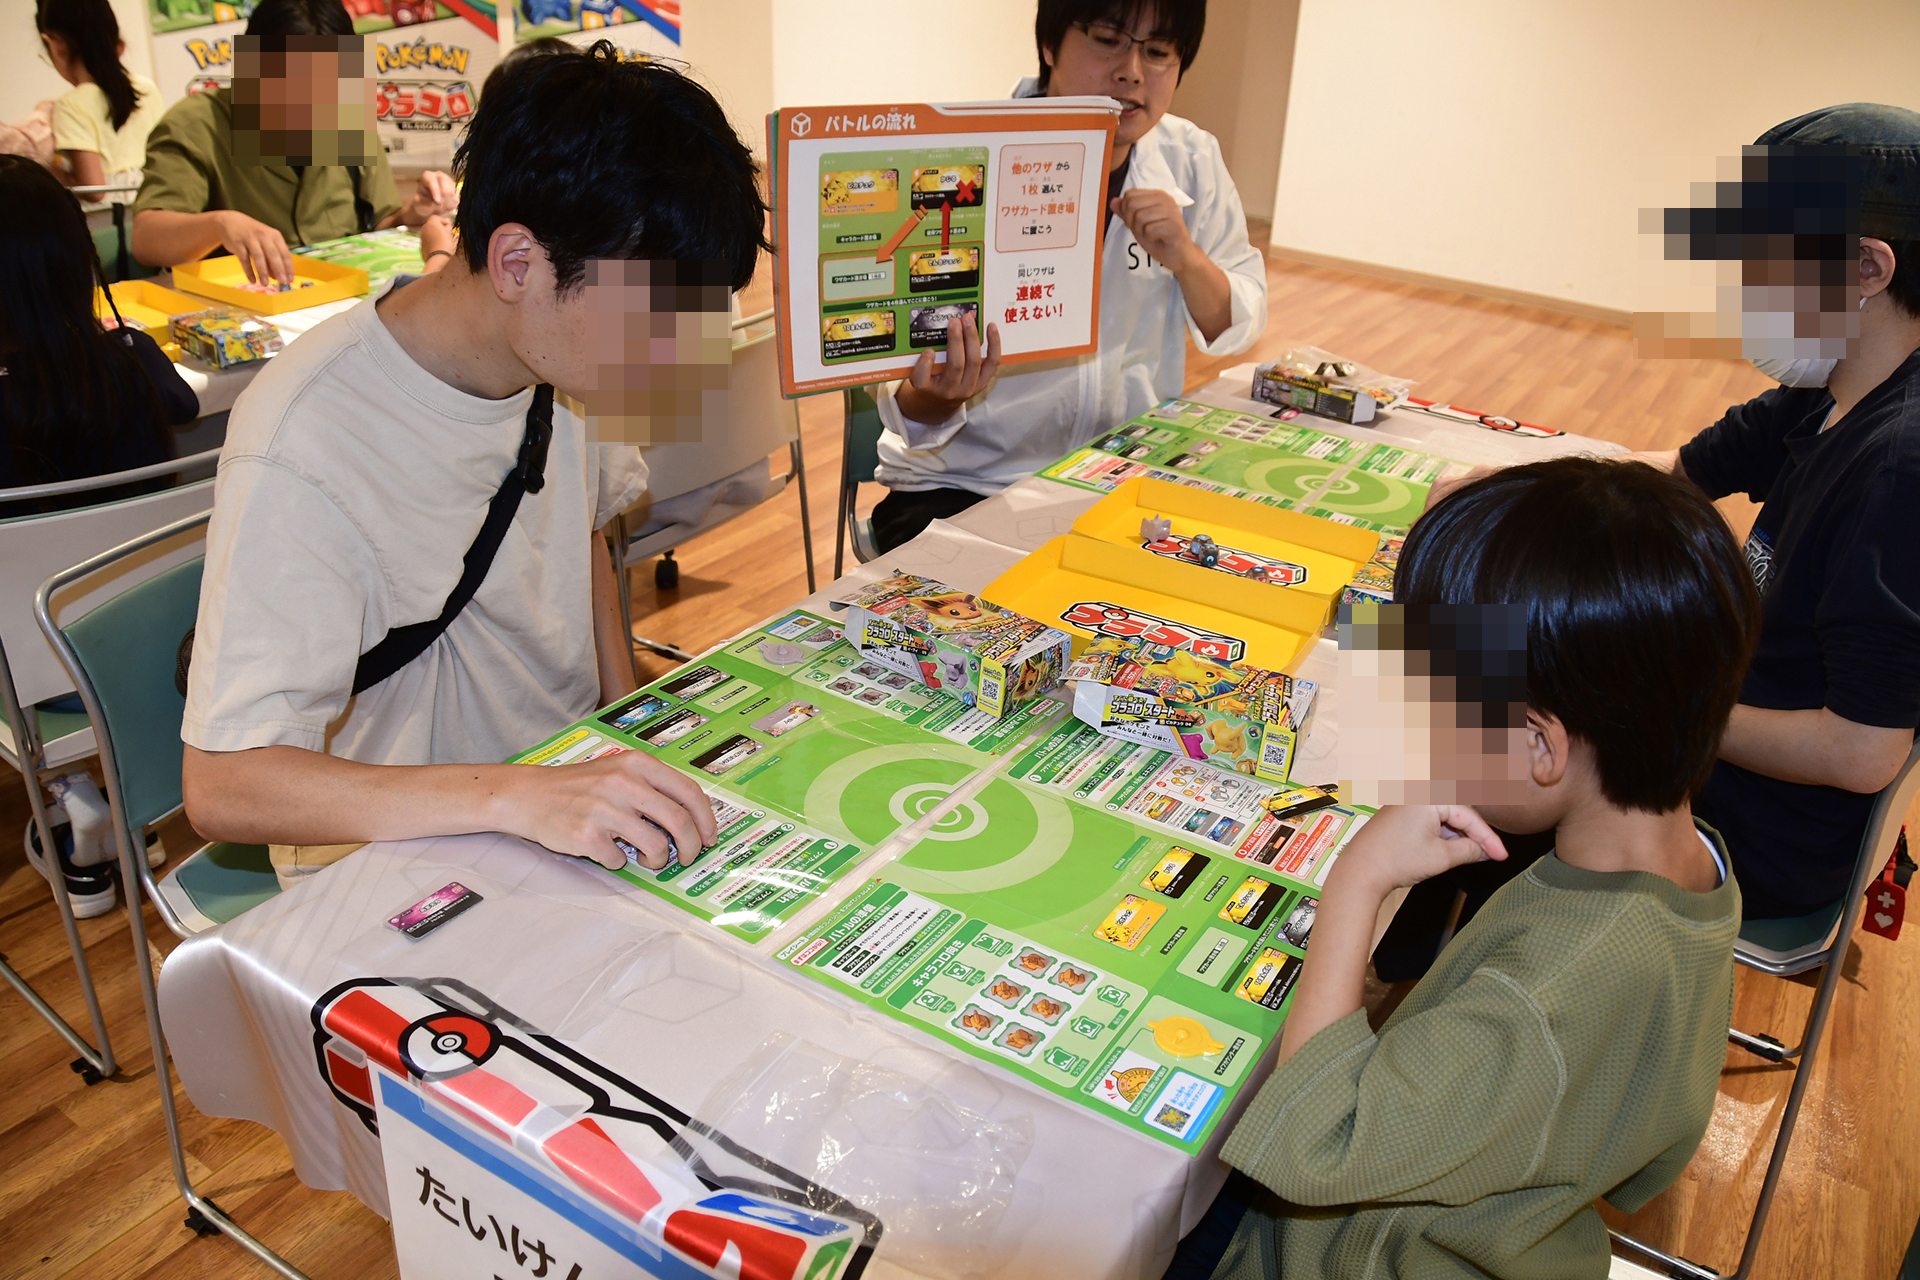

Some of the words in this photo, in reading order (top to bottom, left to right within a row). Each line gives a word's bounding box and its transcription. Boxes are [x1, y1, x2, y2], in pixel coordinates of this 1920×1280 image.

[825, 113, 916, 132] バトルの流れ
[1012, 162, 1053, 174] 他のワザ
[1055, 162, 1070, 171] から
[1021, 184, 1038, 195] 1枚
[1042, 184, 1063, 193] 選んで
[1001, 202, 1075, 217] ワザカード置き場
[1022, 226, 1052, 235] に置こう
[1018, 267, 1055, 278] 同じワザは
[1016, 284, 1055, 301] 連続で
[1004, 303, 1063, 323] 使えない!
[867, 625, 891, 640] プラコロ
[892, 631, 915, 645] スタート
[1111, 701, 1143, 716] プラコロ
[1145, 703, 1175, 718] スタート
[1117, 725, 1172, 743] みんなと一緒に対戦だ!
[1034, 732, 1067, 758] バトルの流れ
[760, 831, 781, 845] キャラコロ
[733, 851, 752, 864] エネコロ
[777, 868, 824, 905] バルの流れ
[747, 890, 771, 908] ワザカード
[829, 903, 876, 941] バトルの準備
[837, 936, 855, 950] キャラコロ
[859, 920, 874, 932] エネコロ
[781, 939, 805, 956] プレイシート
[899, 941, 914, 956] ワザカード
[836, 947, 857, 966] キャラカード
[848, 953, 865, 969] ワザカード
[913, 938, 964, 987] キャラコロ向き
[854, 955, 878, 976] ライフカウンター
